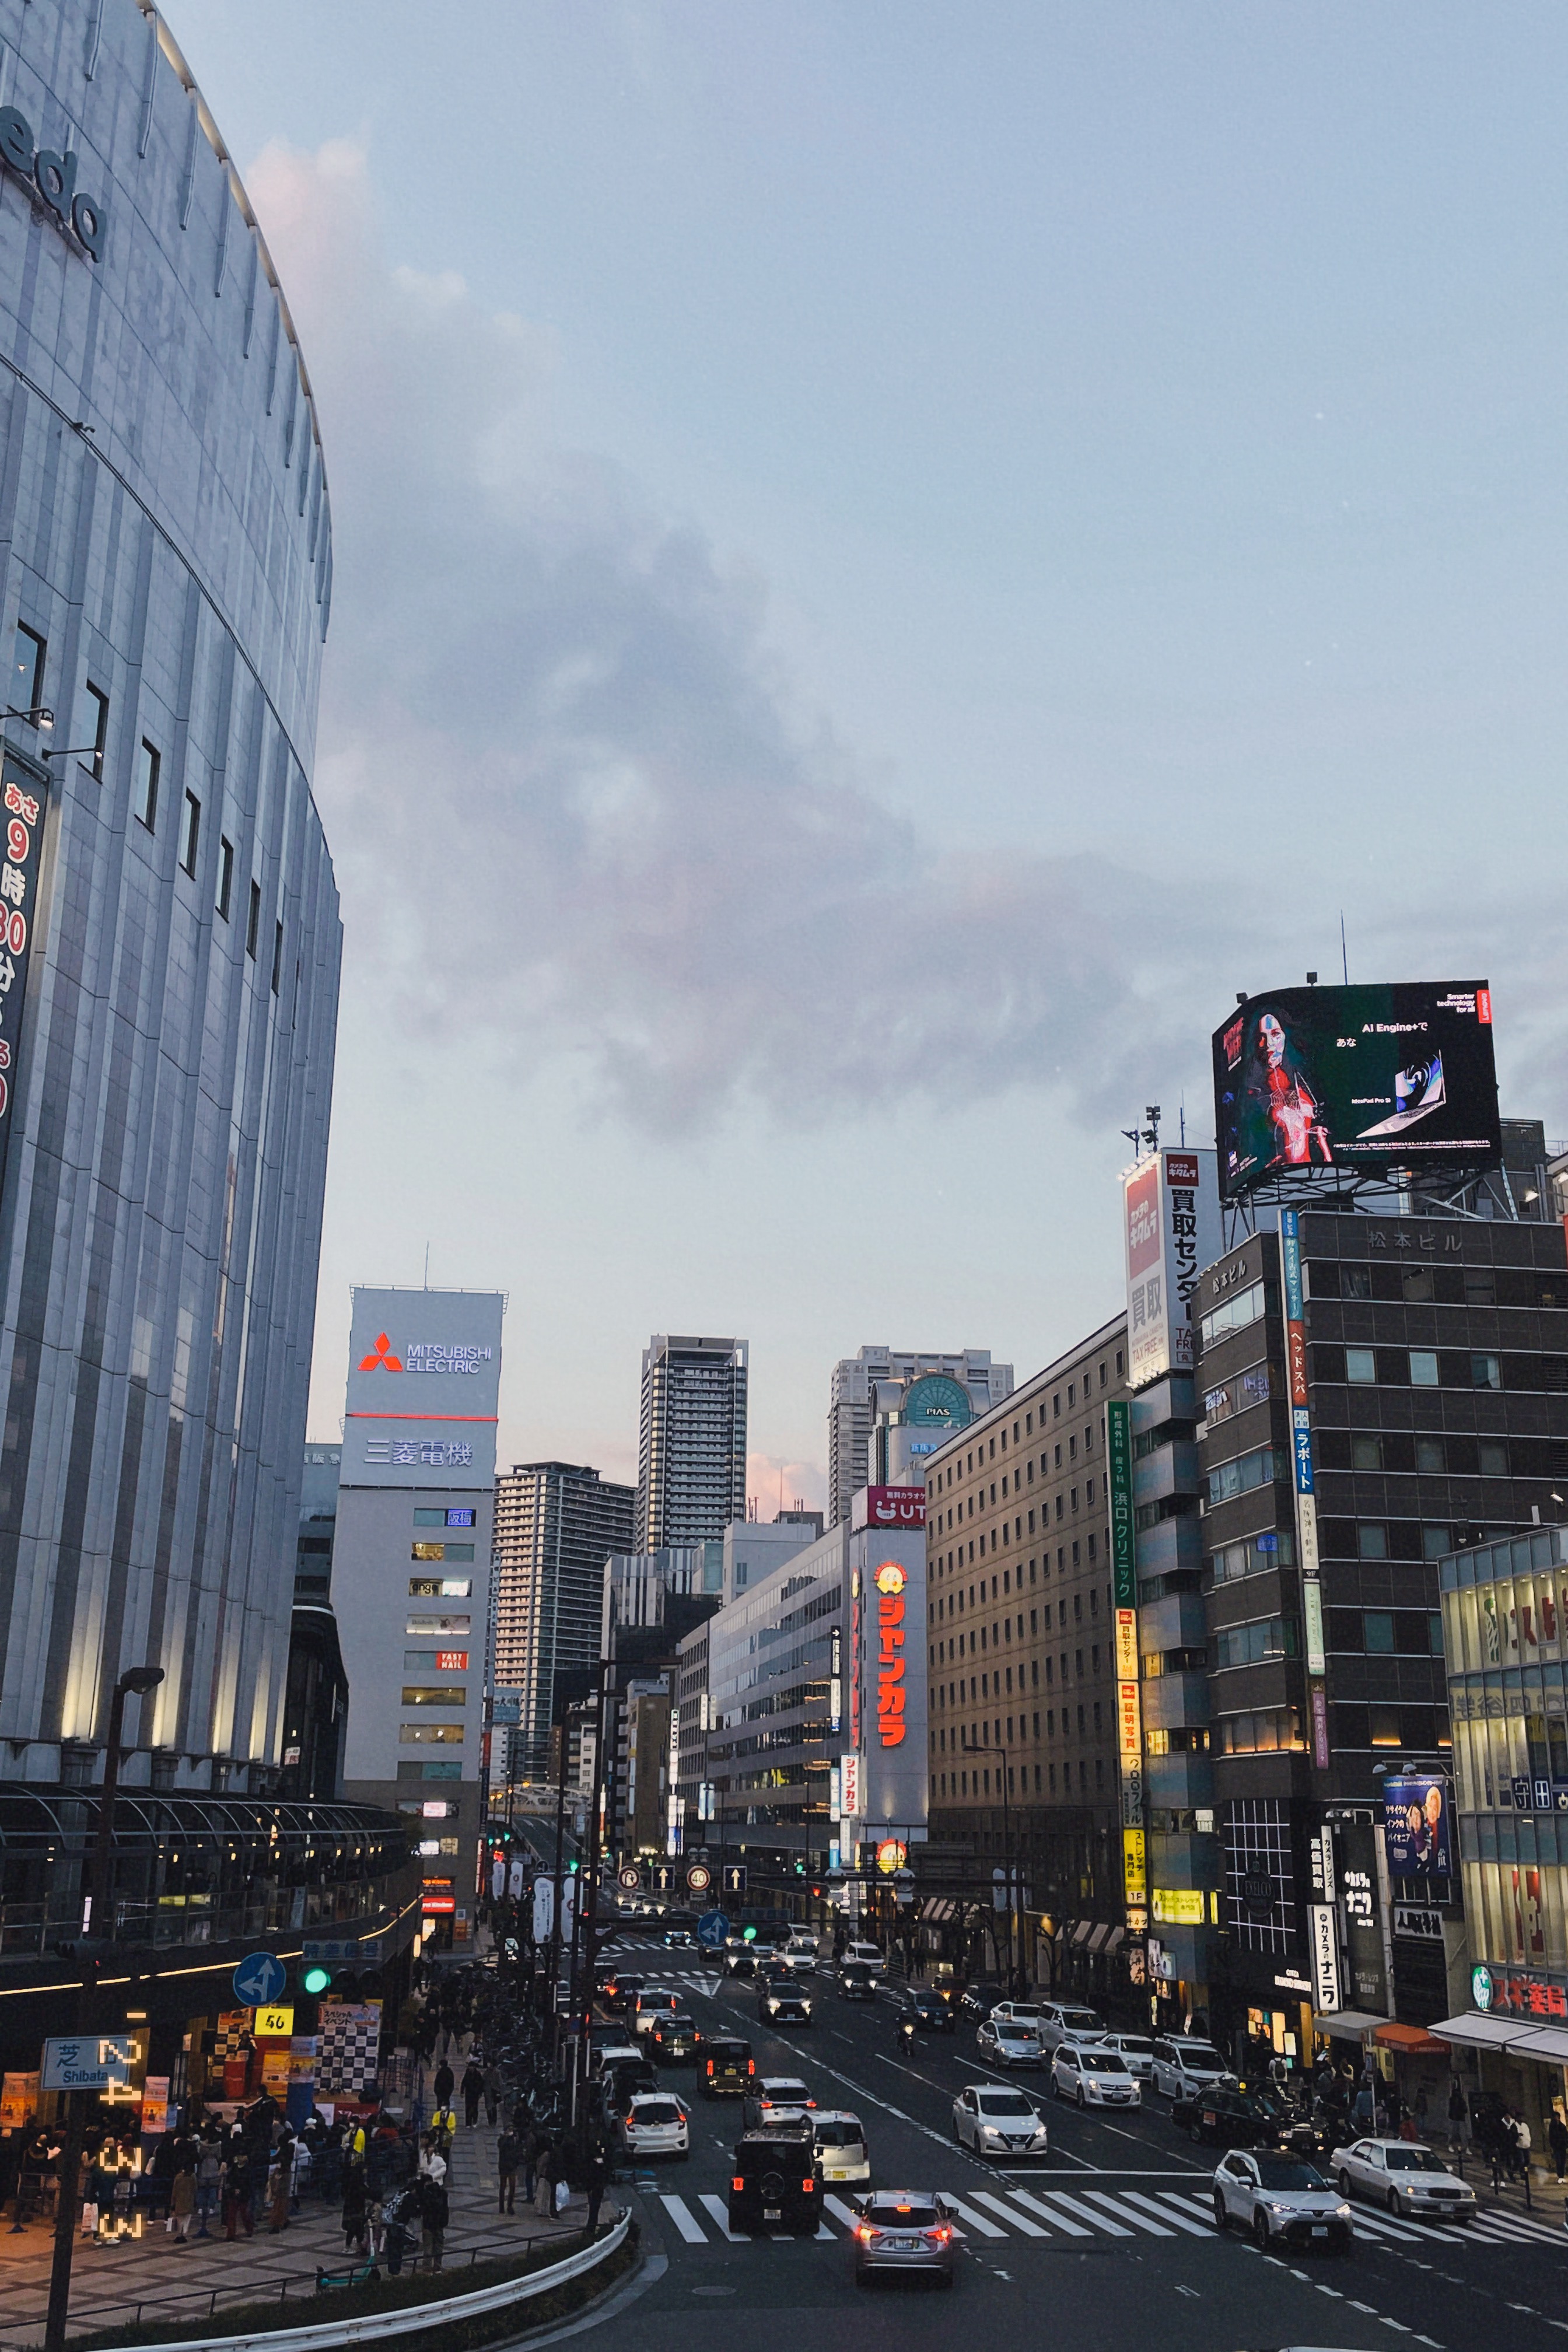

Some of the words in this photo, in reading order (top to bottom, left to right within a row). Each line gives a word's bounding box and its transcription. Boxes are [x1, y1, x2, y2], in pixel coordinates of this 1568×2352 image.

[1480, 992, 1490, 1021] Lenovo
[1362, 1024, 1373, 1032] AI
[1168, 1169, 1197, 1178] キタムラ
[1130, 1209, 1158, 1249] キタムラ
[1368, 1231, 1462, 1252] 松本ビル
[1212, 1259, 1247, 1296] 松本ビル
[1132, 1275, 1162, 1333] 買取
[406, 1359, 480, 1374] ELECTRIC
[407, 1345, 491, 1361] MITSUBISHI
[1291, 1332, 1306, 1394] ヘッドスパ
[364, 1439, 473, 1466] 三菱電機
[1297, 1433, 1311, 1489] ラポート
[1115, 1492, 1130, 1597] 浜口クリニック
[441, 1653, 463, 1661] FAST
[877, 1596, 906, 1746] ジャンカラ
[846, 1758, 856, 1812] ジャンカラ
[692, 1873, 705, 1883] 40
[1245, 1880, 1272, 1897] EXELCO
[1130, 1892, 1142, 1902] 1F
[1492, 1974, 1568, 2018] スギ薬局
[63, 2070, 109, 2083] Shibata
